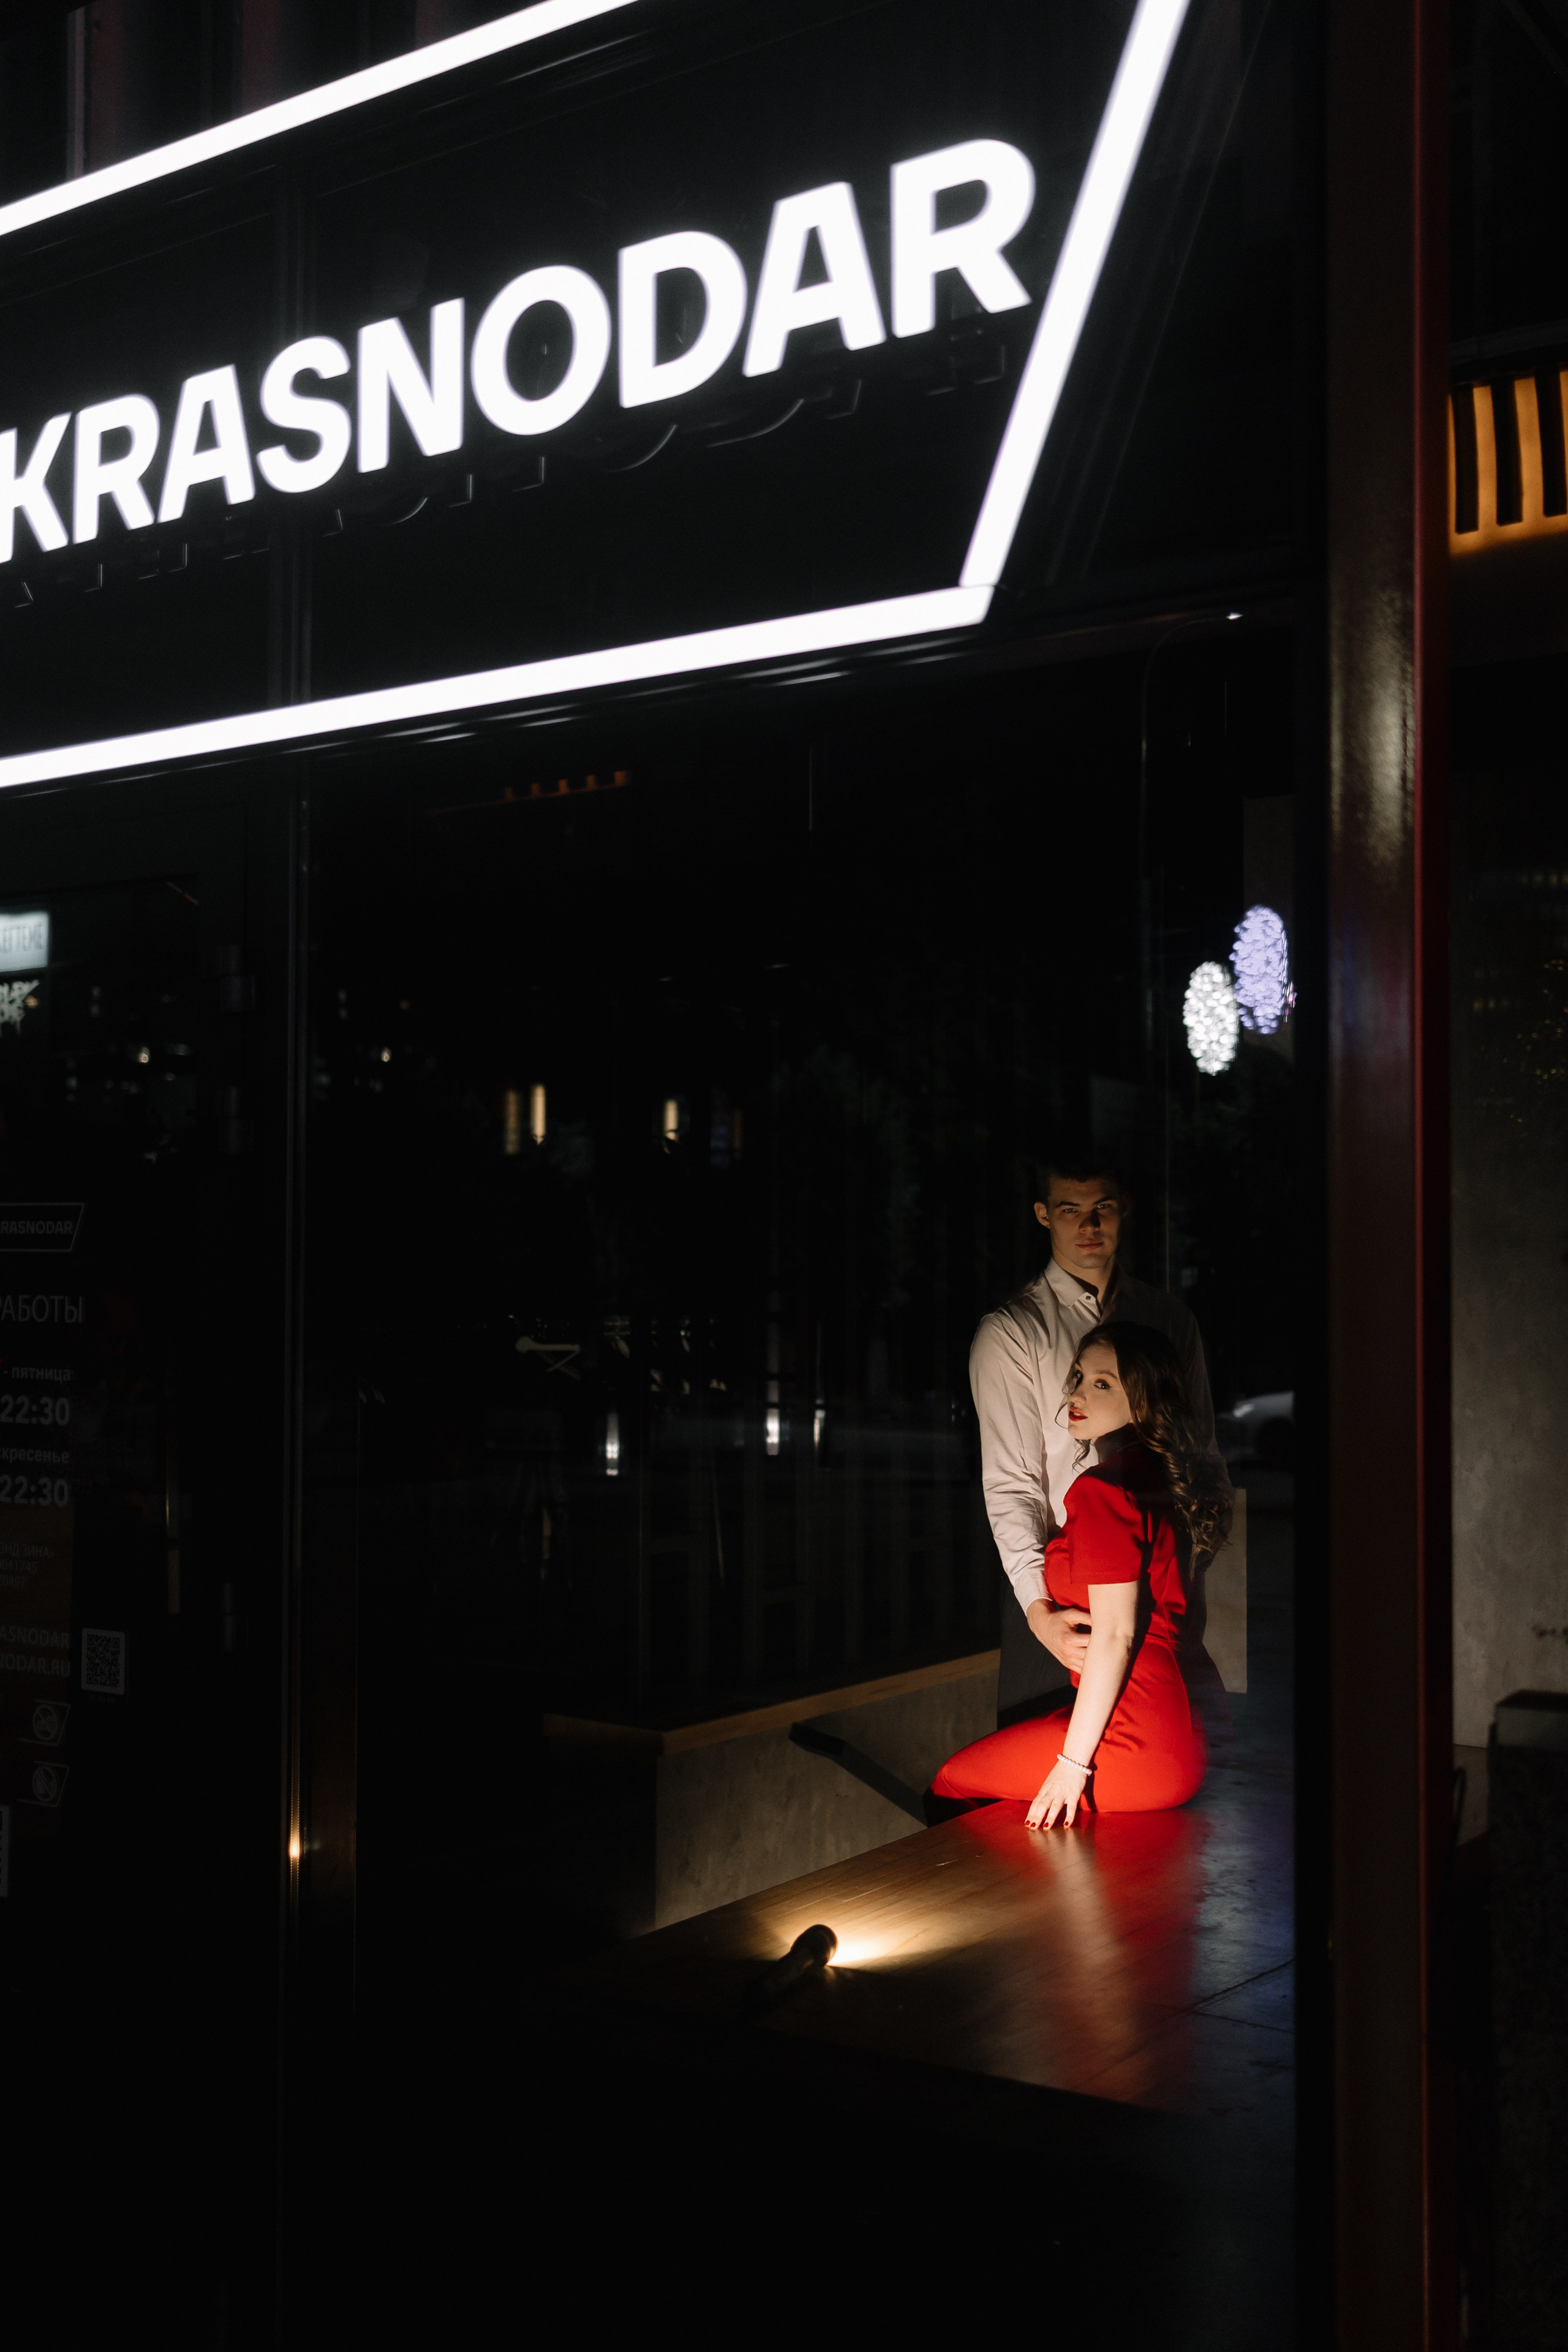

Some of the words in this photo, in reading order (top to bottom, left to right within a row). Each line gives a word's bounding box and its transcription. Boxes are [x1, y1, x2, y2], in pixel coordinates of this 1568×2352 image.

[0, 139, 1035, 564] KRASNODAR
[0, 1294, 83, 1323] АБОТЫ
[12, 1366, 71, 1384] пятница
[0, 1394, 70, 1427] 22:30
[0, 1447, 69, 1464] кресенье
[0, 1474, 69, 1507] 22:30
